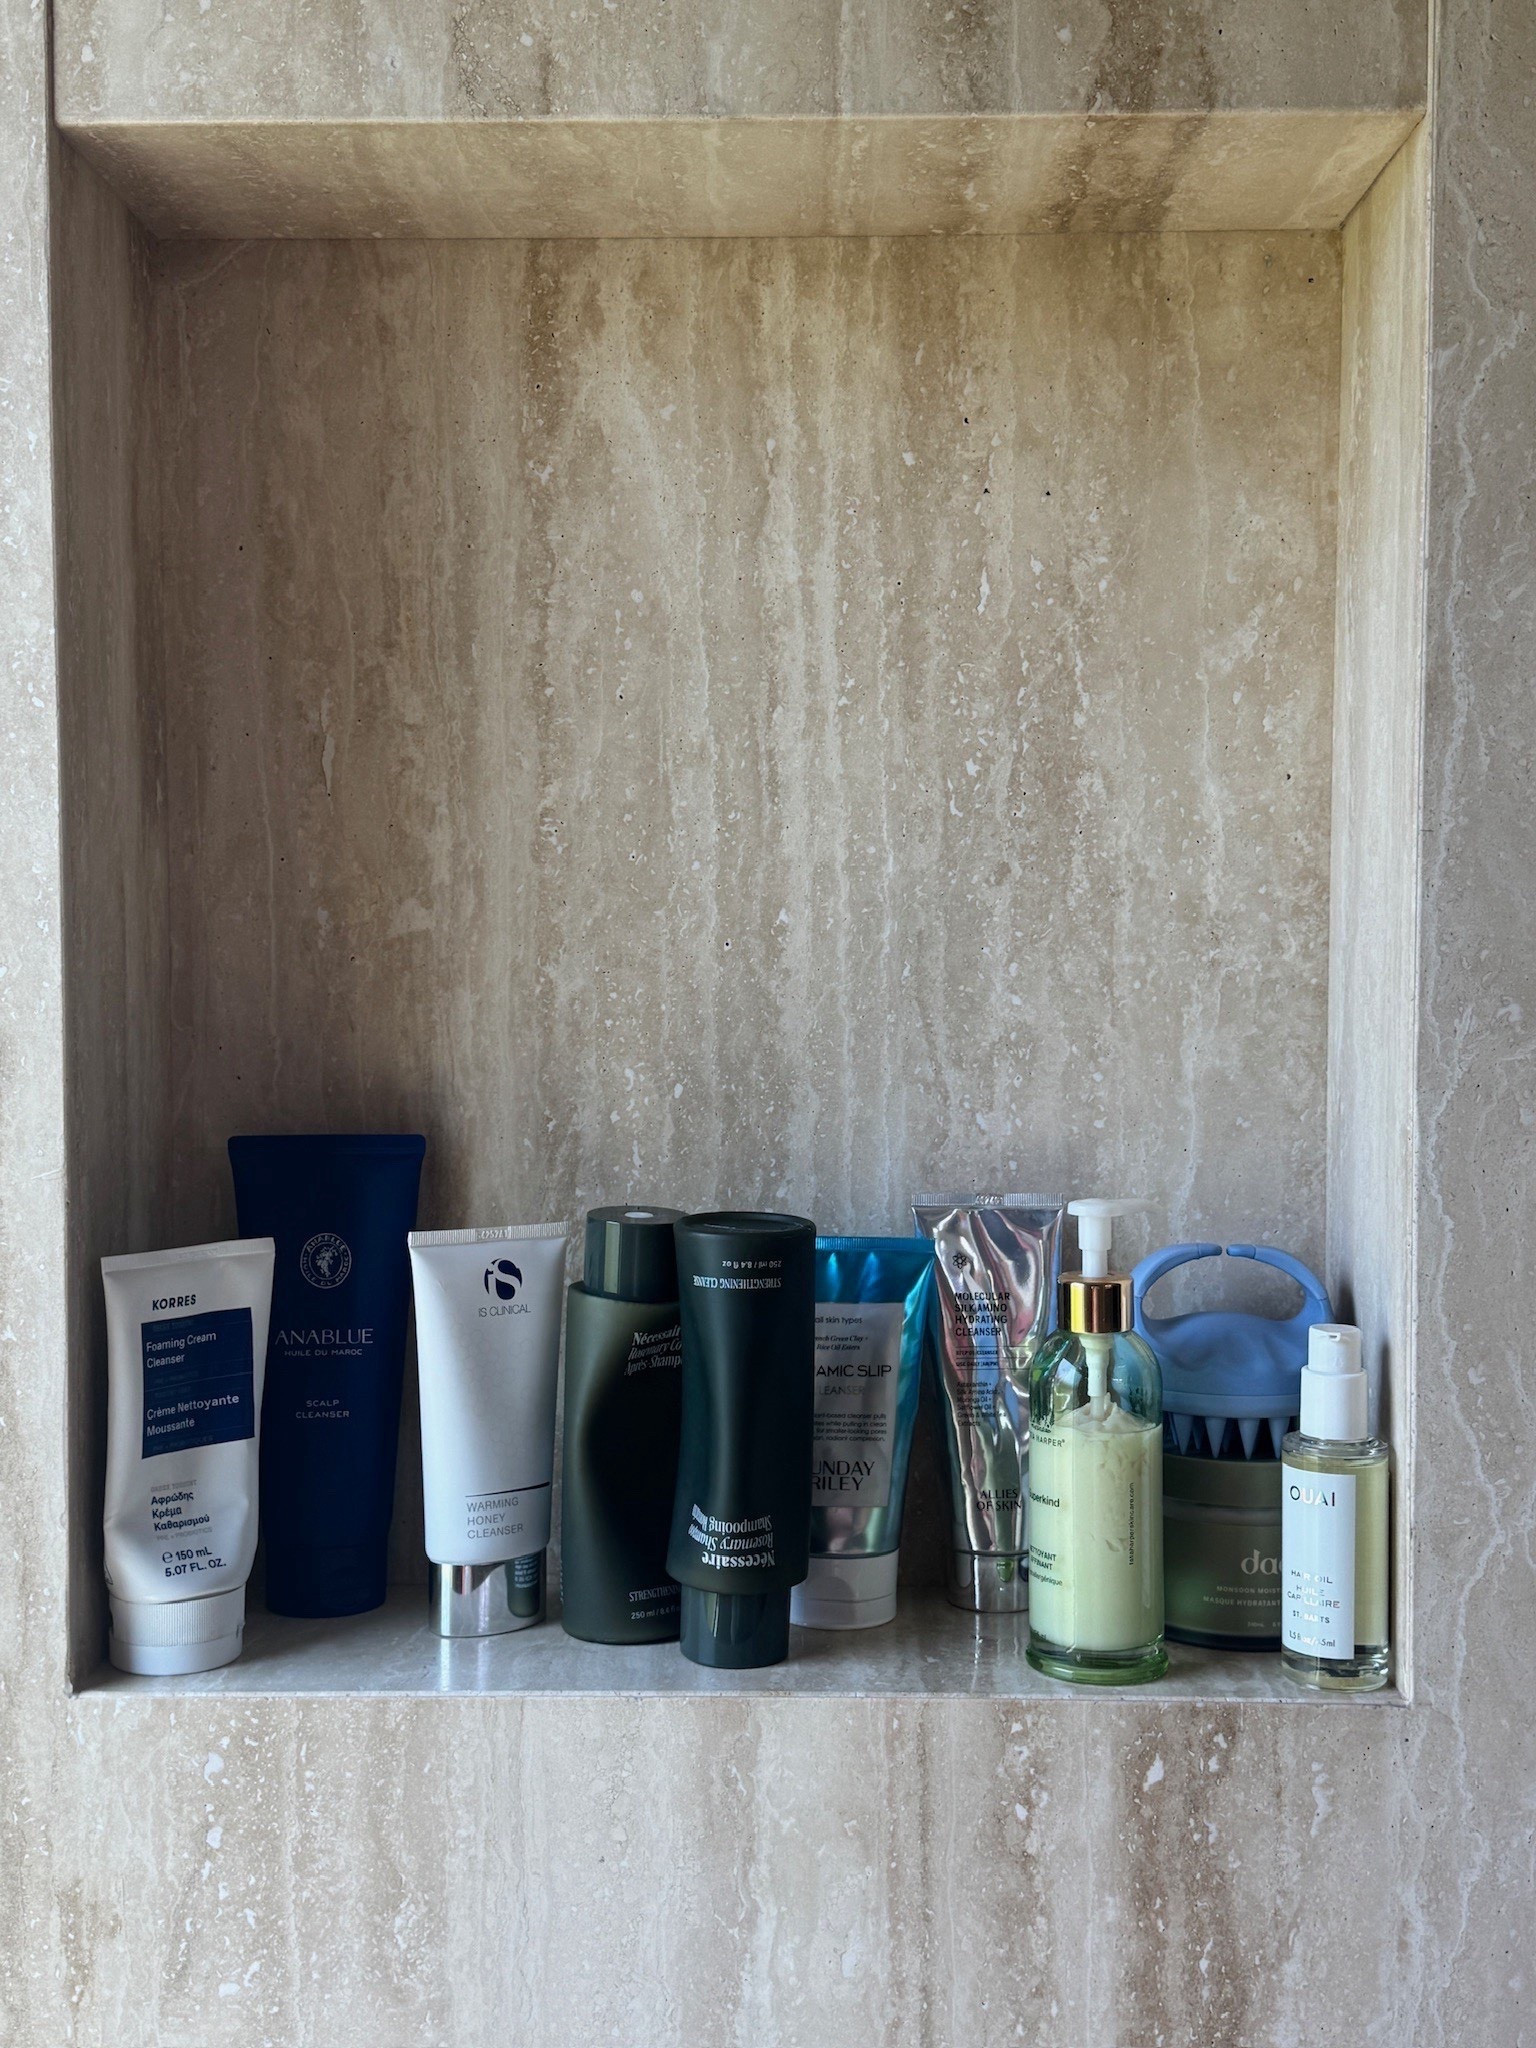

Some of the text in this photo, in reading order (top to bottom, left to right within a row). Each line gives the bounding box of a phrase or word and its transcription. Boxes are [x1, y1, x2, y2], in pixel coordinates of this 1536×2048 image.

[722, 1260, 732, 1268] oz
[720, 1277, 783, 1290] STRENGTHENING
[152, 1294, 197, 1311] KORRES
[955, 1292, 1010, 1302] MOLECULAR
[490, 1303, 532, 1316] CLINICAL
[955, 1303, 1007, 1313] SILK AMINO
[955, 1315, 1007, 1325] HYDRATING
[275, 1328, 374, 1345] ANABLUE
[955, 1327, 1002, 1338] CLEANSER
[147, 1332, 216, 1352] Foaming Cream
[285, 1348, 363, 1358] HUILE DU MAROC
[147, 1354, 185, 1368] Cleanser
[816, 1364, 892, 1378] AMIC SLIP
[147, 1394, 240, 1420] Crème Nettoyante
[307, 1400, 340, 1408] SCALP
[296, 1410, 350, 1419] CLEANSER
[147, 1418, 195, 1437] Moussante
[811, 1476, 864, 1491] RILEY
[151, 1492, 194, 1505] Αφρώδης
[980, 1488, 1018, 1500] ALLIES
[1290, 1485, 1337, 1507] OUAI
[467, 1497, 519, 1512] WARMING
[976, 1500, 1021, 1512] OF SKIN
[152, 1507, 182, 1519] Κρέμα
[467, 1513, 506, 1526] HONEY
[154, 1514, 210, 1531] Καθαρισμού
[708, 1515, 773, 1536] Shampooing
[467, 1523, 524, 1540] CLEANSER
[719, 1532, 774, 1551] Rosemary
[176, 1550, 193, 1561] 150
[196, 1547, 212, 1558] mL
[701, 1550, 776, 1570] Nécessaire
[165, 1558, 226, 1577] 5.07 FL. OZ.
[1241, 1548, 1282, 1575] da
[1216, 1586, 1255, 1594] MONSOON
[631, 1610, 645, 1620] 250
